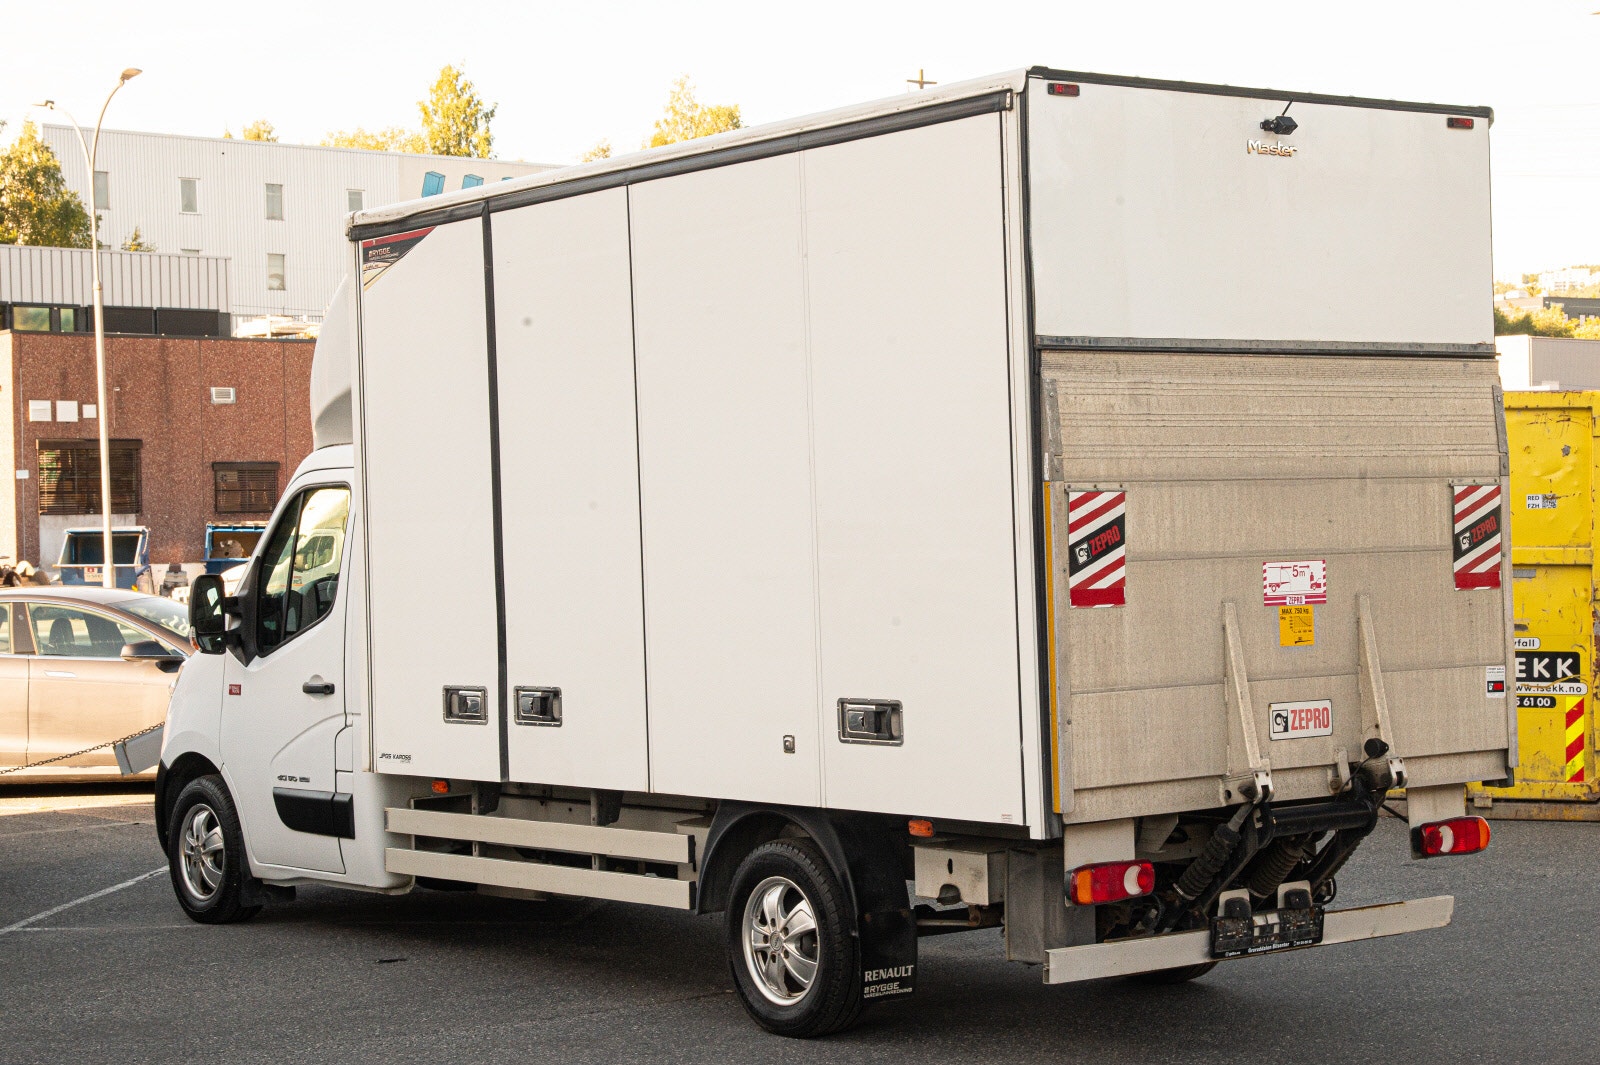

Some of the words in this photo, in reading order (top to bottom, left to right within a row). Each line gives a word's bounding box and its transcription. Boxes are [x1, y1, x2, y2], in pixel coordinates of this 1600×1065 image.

[1246, 139, 1298, 157] Master
[1470, 515, 1498, 543] ZEPRO
[1089, 524, 1121, 556] ZEPRO
[1288, 596, 1303, 605] ZEPRO
[1290, 706, 1330, 731] ZEPRO
[864, 964, 914, 983] RENAULT
[864, 981, 900, 994] BRYGGE
